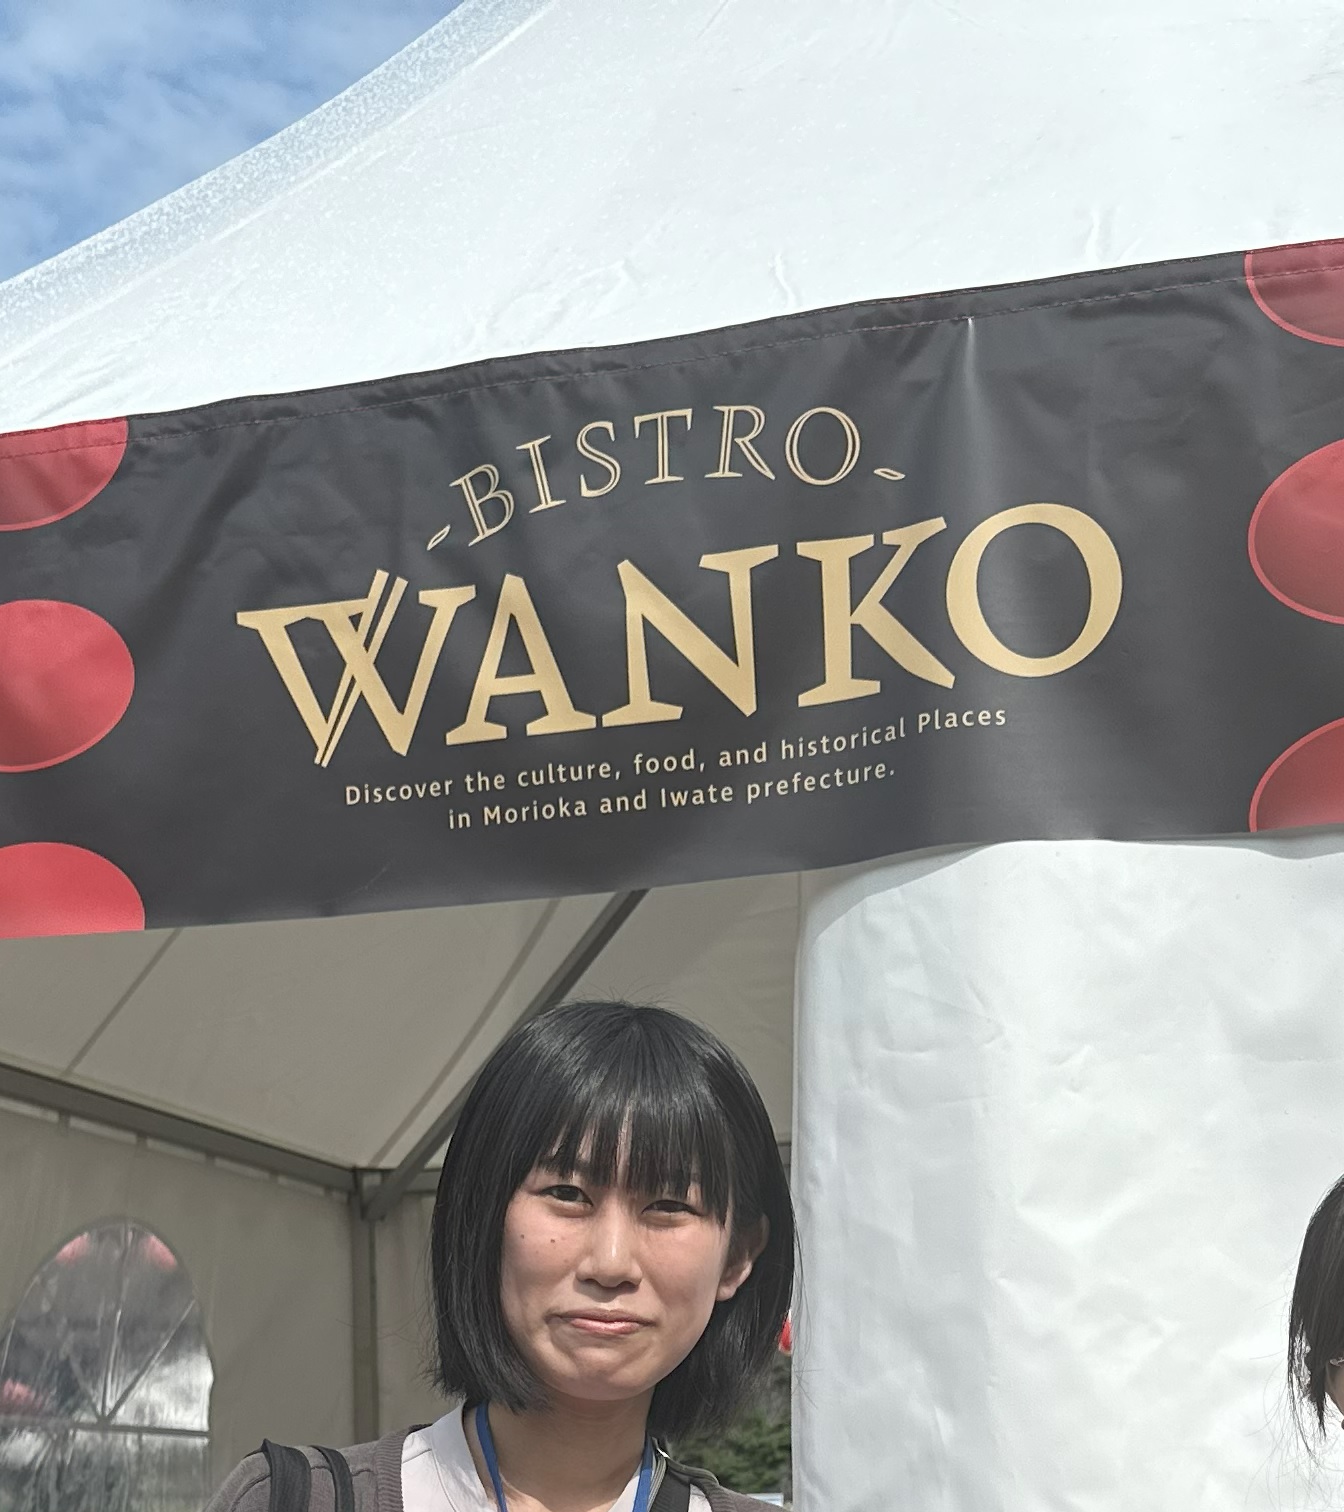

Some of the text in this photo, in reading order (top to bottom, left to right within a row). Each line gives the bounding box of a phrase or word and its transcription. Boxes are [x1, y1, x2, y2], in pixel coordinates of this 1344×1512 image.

[236, 502, 1123, 768] WANKO
[344, 705, 1007, 806] Discover the culture, food, and historical Places
[448, 762, 896, 830] in Morioka and Iwate prefecture.
